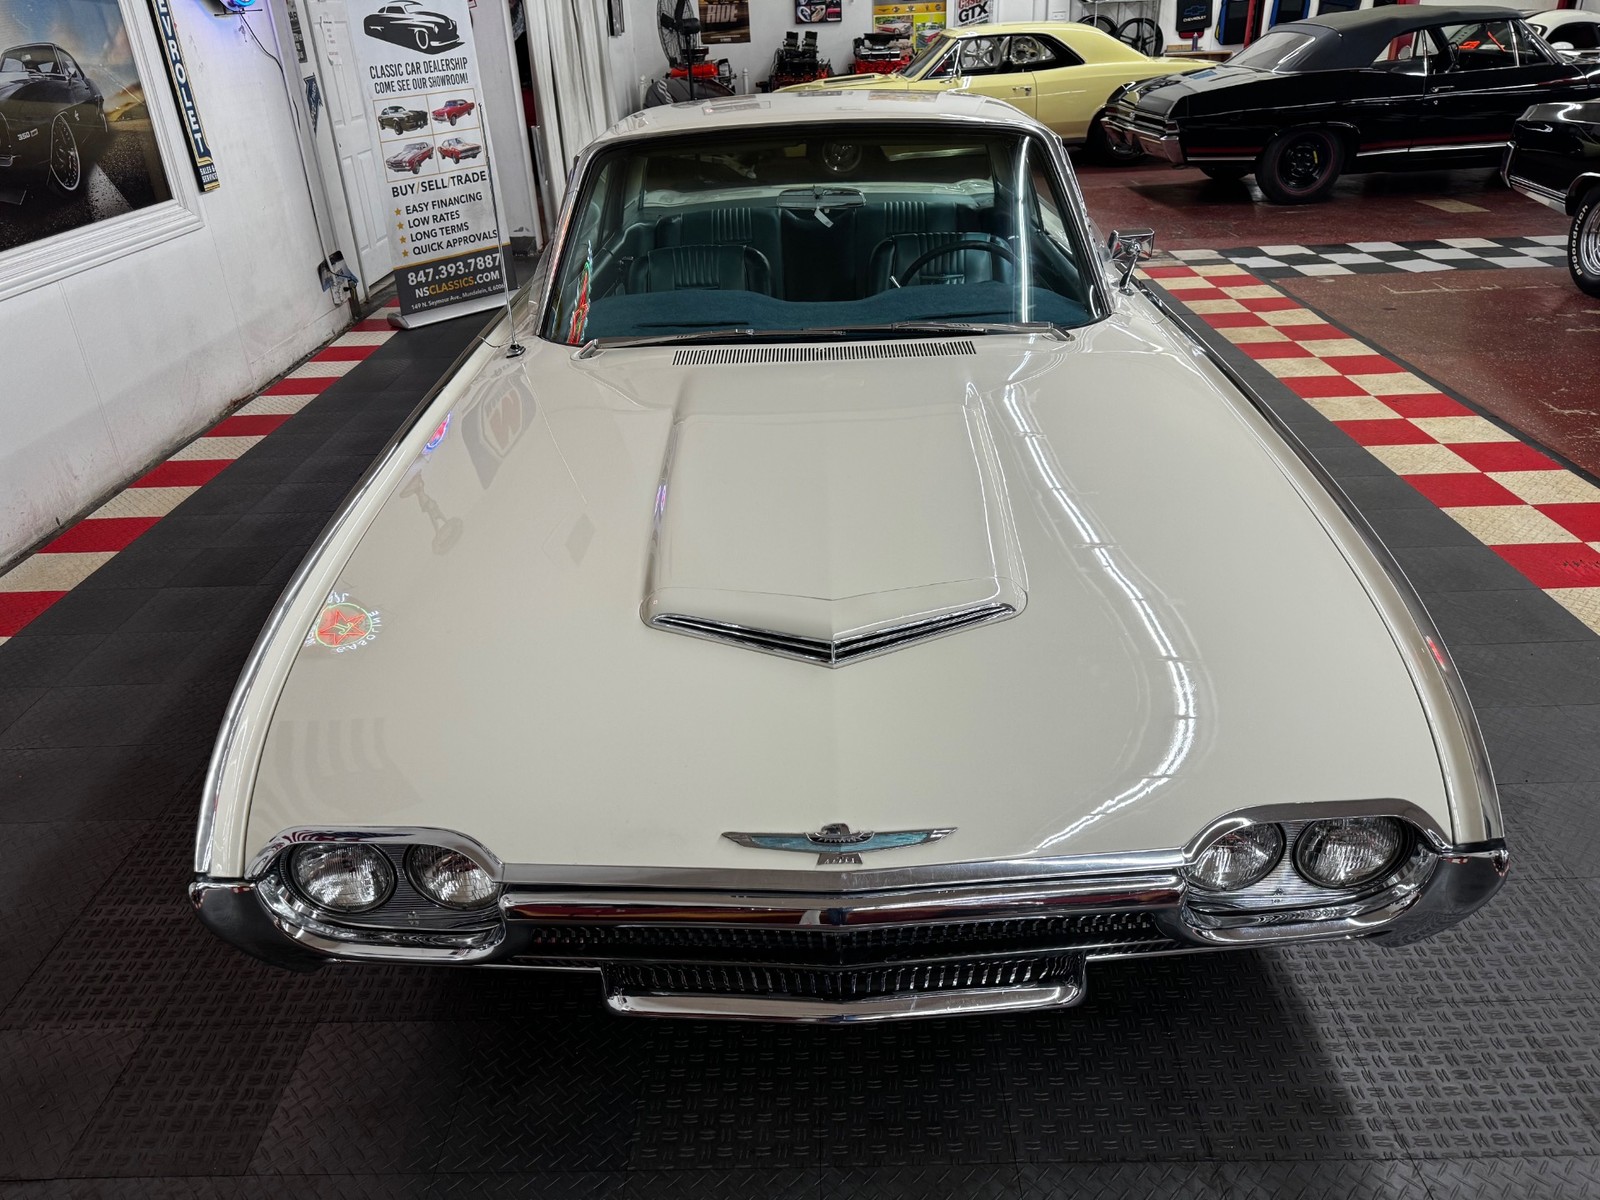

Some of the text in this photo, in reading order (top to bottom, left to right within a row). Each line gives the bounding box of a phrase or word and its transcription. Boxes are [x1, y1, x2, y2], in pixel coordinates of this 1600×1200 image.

[706, 4, 738, 23] RIDE
[959, 1, 988, 22] GTX
[369, 56, 468, 79] CLASSIC CAR DEALERSHIP
[374, 72, 469, 94] COME SEE OUR SHOWROOM!
[391, 170, 487, 198] BUY/SELL/TRADE
[405, 191, 483, 214] EASY FINANCING
[407, 210, 460, 229] LOW RATES
[410, 222, 469, 242] LONG TERMS
[412, 229, 498, 256] QUICK APPROVALS
[407, 253, 501, 286] 847.393.7887
[415, 270, 500, 299] NSCLASSICS.COM
[428, 297, 449, 307] Seymour
